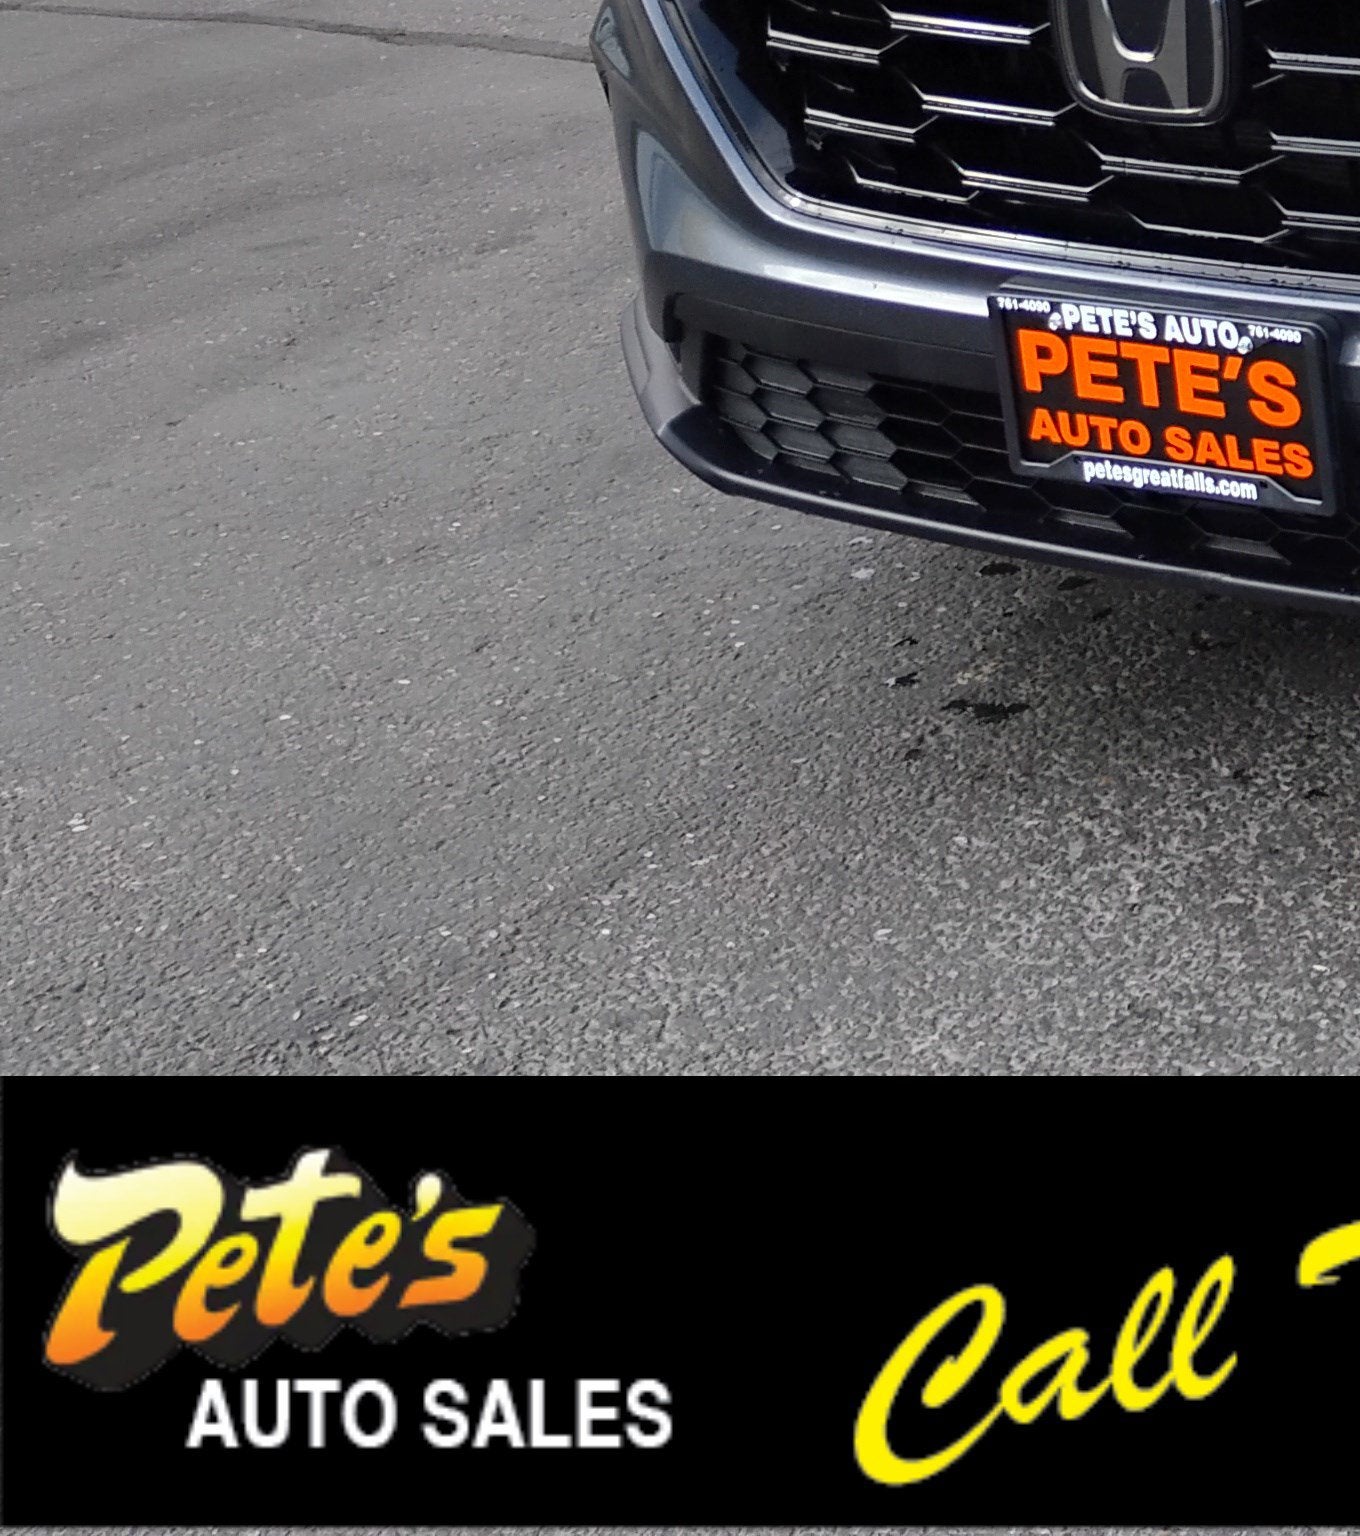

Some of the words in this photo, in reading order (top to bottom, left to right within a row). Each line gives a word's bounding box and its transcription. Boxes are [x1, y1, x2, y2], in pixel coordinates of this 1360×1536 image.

[997, 296, 1051, 314] 761-4090
[1061, 303, 1157, 339] PETE'S
[1164, 316, 1239, 349] AUTO
[1247, 324, 1302, 344] 761-4090
[1016, 328, 1302, 427] PETE'S
[1029, 407, 1151, 455] AUTO
[1164, 425, 1314, 479] SALES
[1082, 459, 1258, 500] petesgreatfalls.com
